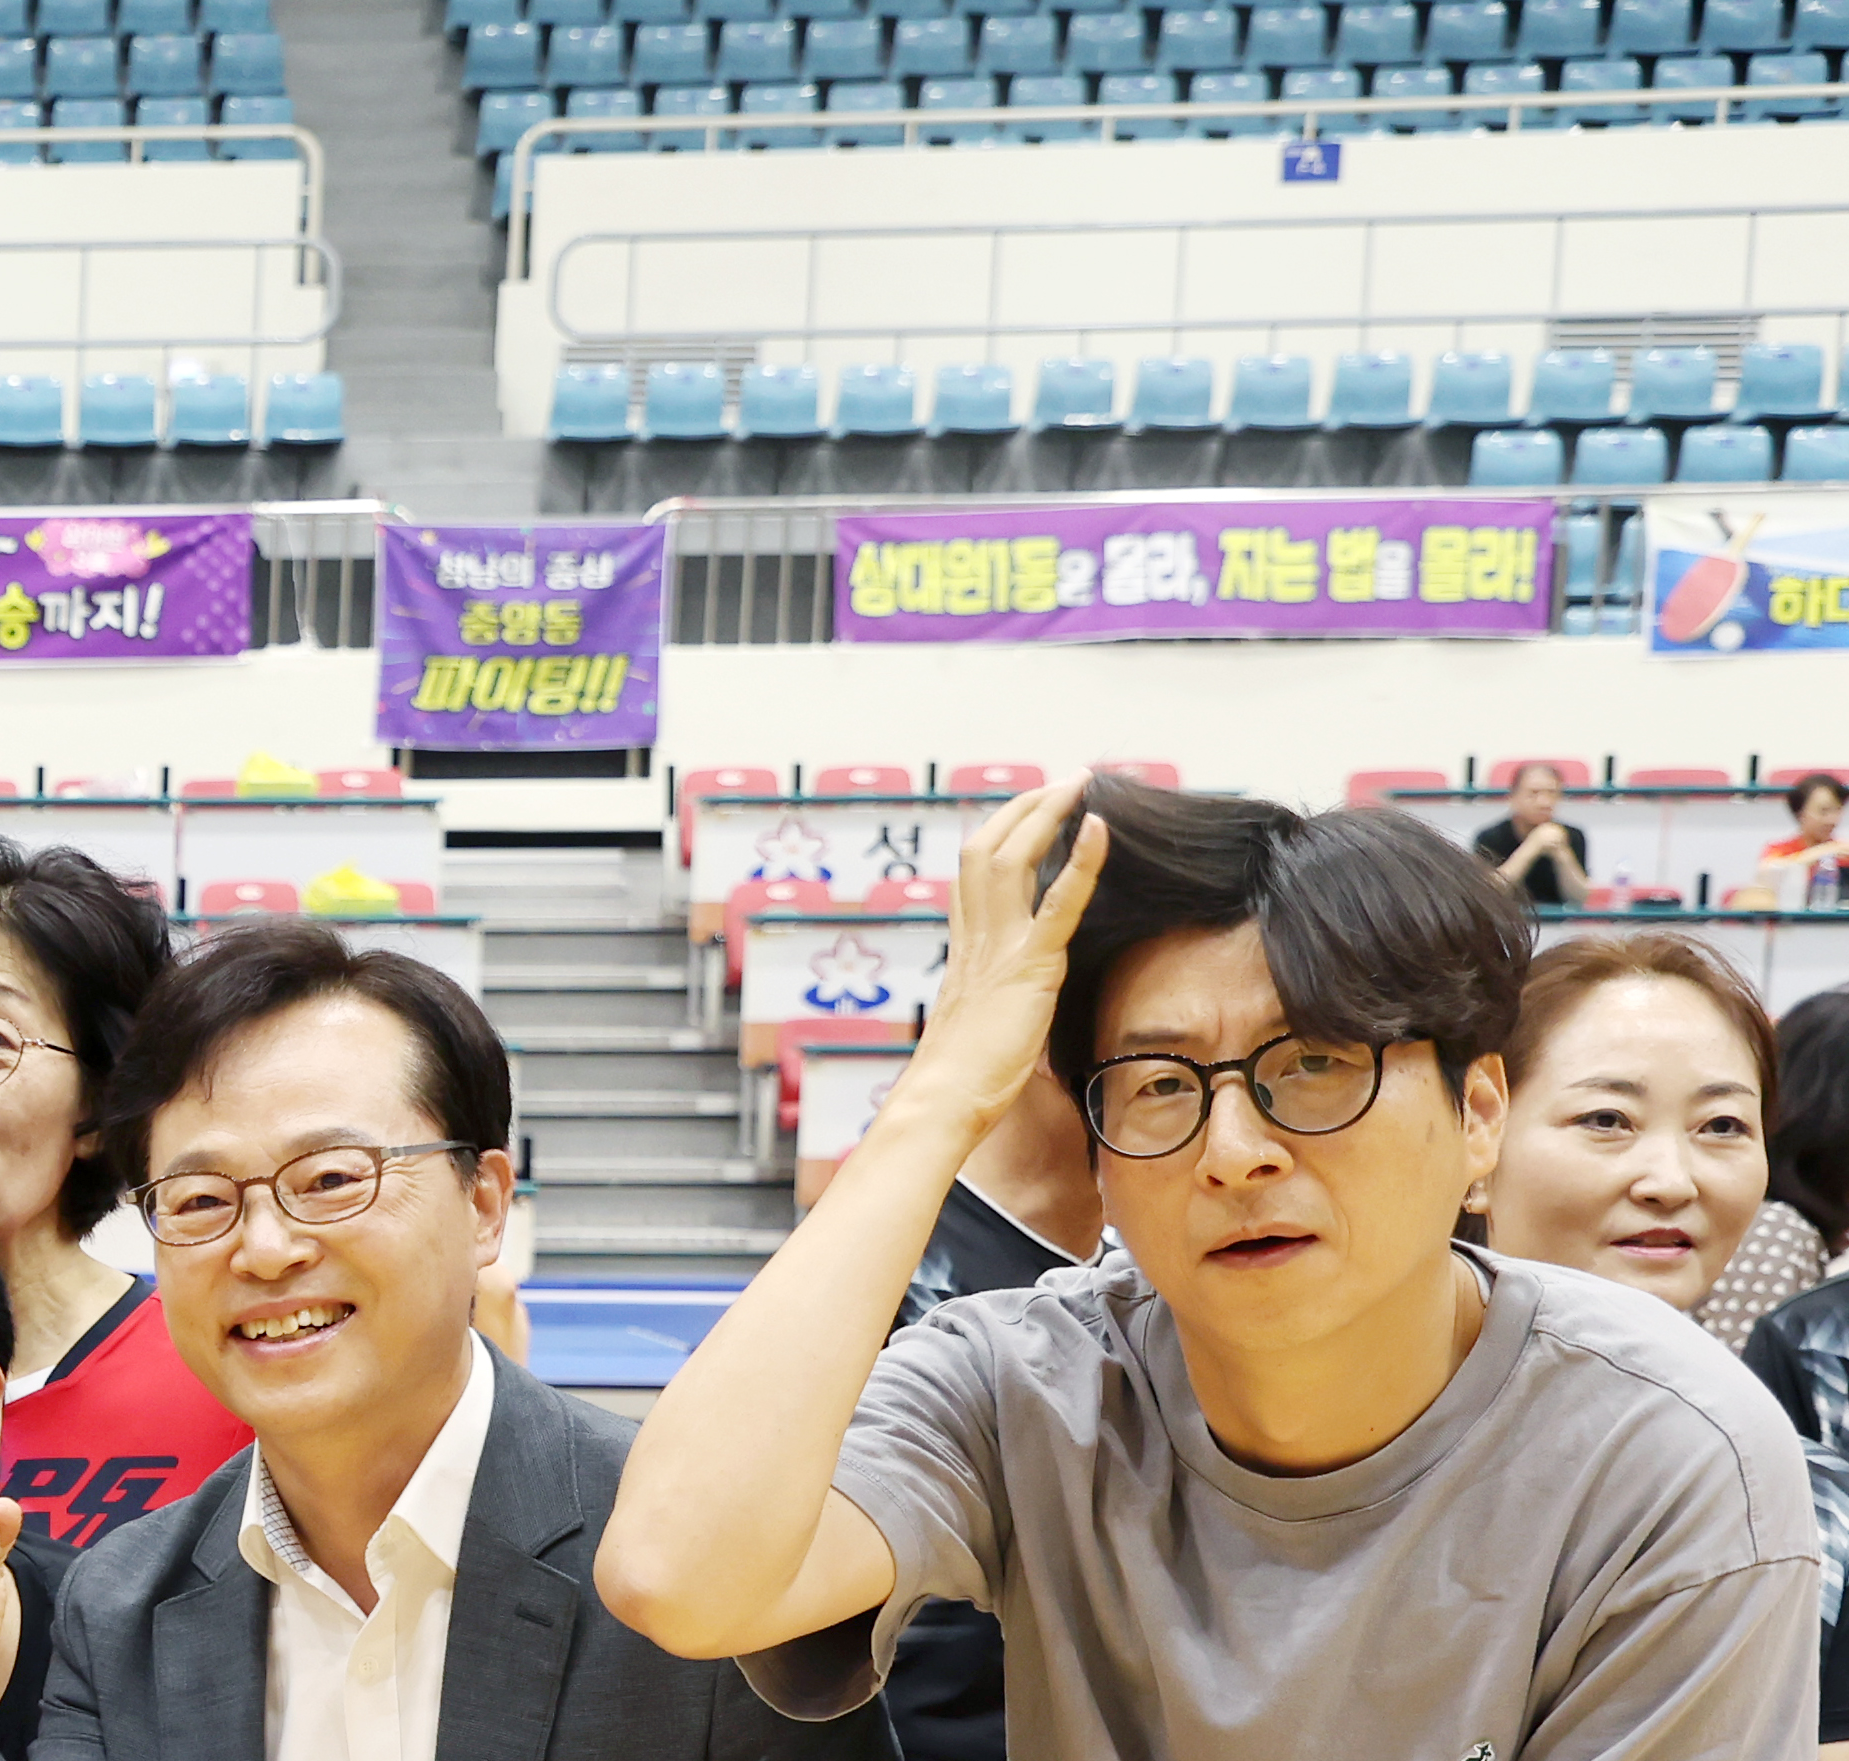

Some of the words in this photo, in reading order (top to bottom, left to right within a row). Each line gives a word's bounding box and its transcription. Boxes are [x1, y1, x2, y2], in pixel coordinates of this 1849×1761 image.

[434, 550, 536, 590] 성남의
[848, 535, 1096, 618] 상대원1동은
[1214, 526, 1320, 604] 지는
[1325, 525, 1414, 603] 법을
[1418, 525, 1538, 604] 몰라!
[458, 599, 582, 646] 중앙동
